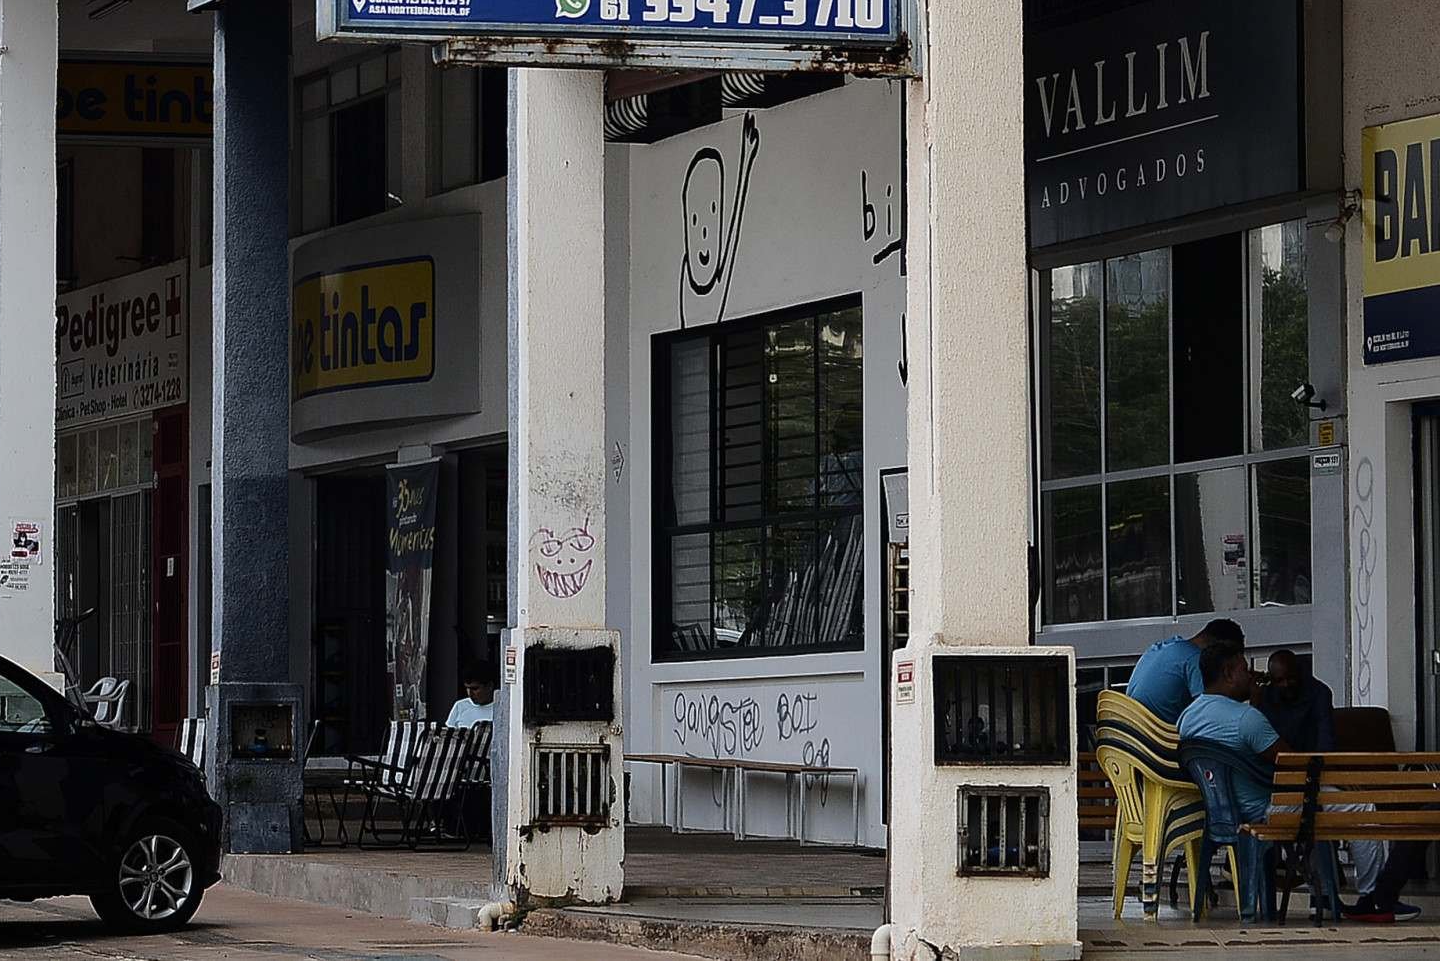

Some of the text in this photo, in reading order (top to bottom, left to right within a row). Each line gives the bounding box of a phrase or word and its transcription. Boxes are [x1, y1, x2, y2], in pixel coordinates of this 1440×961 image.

[368, 4, 386, 14] ASA
[1035, 31, 1210, 139] VALLIM
[1040, 149, 1207, 209] ADVOGADOS
[57, 292, 161, 357] Pedigree
[89, 351, 159, 390] Veterinária
